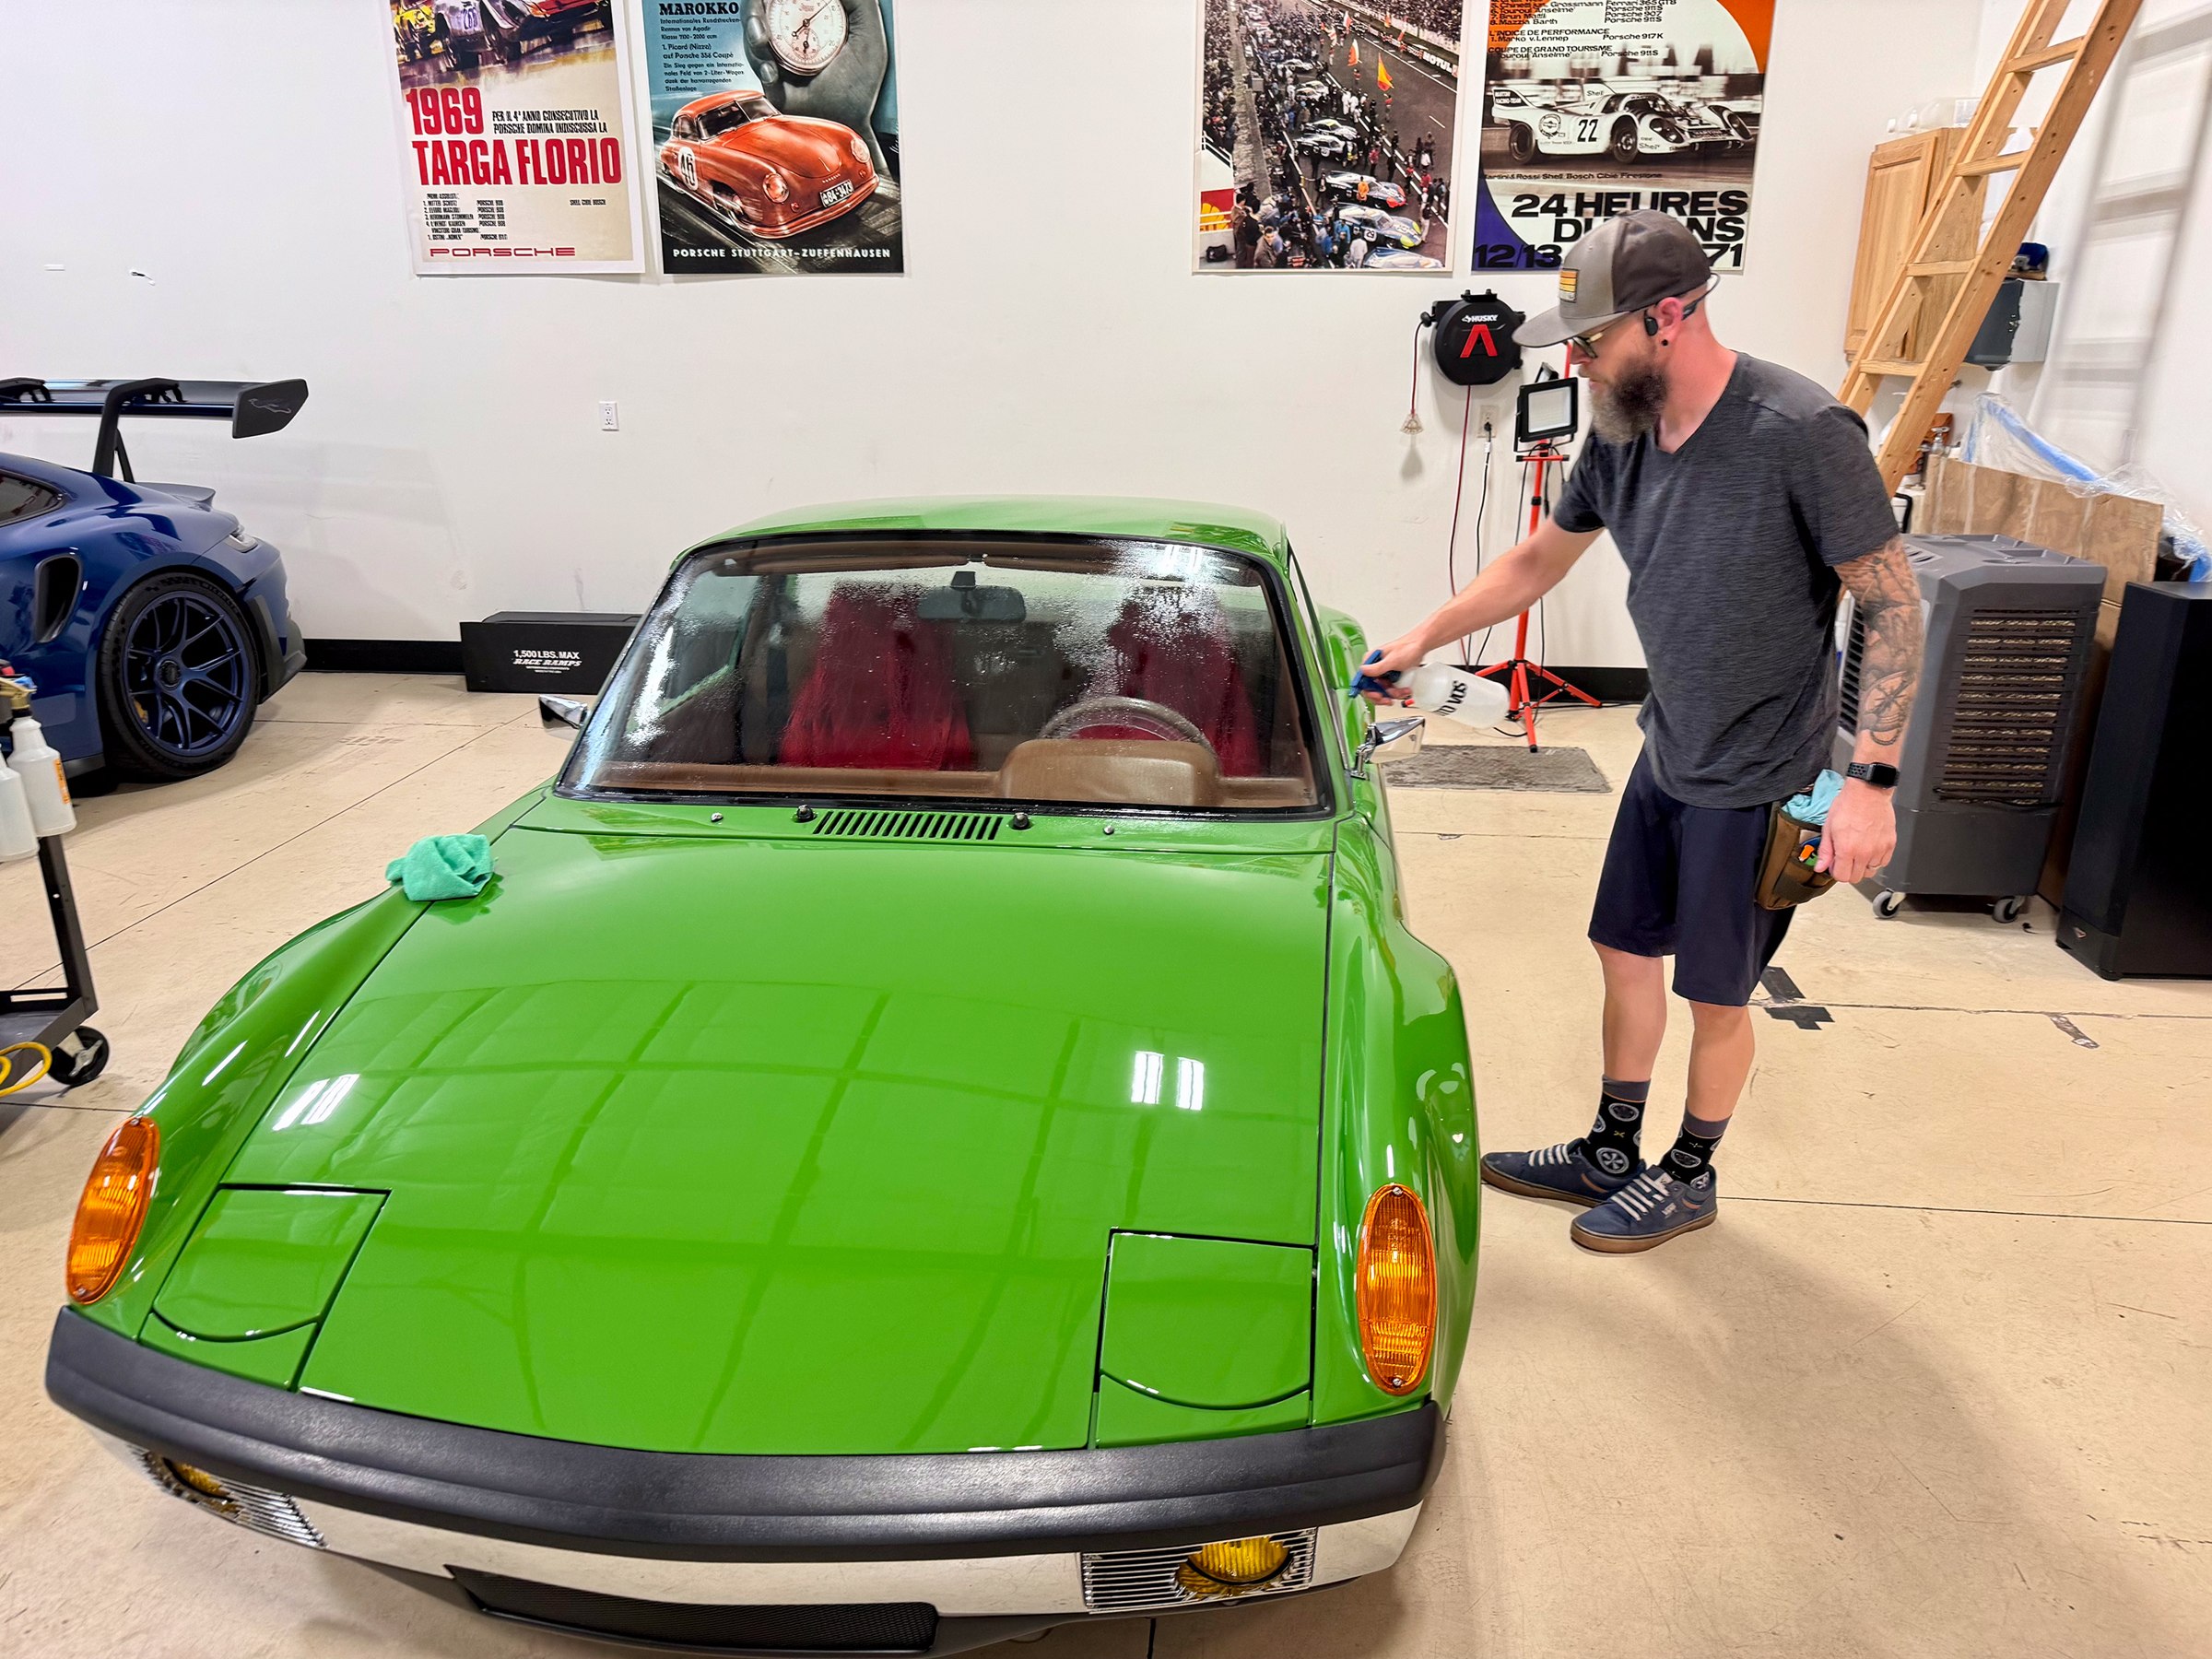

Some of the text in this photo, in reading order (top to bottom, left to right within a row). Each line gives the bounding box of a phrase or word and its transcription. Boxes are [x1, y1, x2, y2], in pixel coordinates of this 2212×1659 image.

[659, 2, 739, 15] MAROKKO
[406, 88, 484, 135] 1969
[492, 111, 505, 121] PER
[523, 110, 541, 121] ANNO
[543, 109, 589, 121] CONSECUTIVO
[590, 110, 599, 120] LA
[493, 122, 608, 134] PORSCHE DOMINA INDISCUSSA LA
[1577, 119, 1598, 142] 22
[412, 137, 622, 185] TARGA FLORIO
[681, 153, 696, 186] 46
[1512, 190, 1748, 218] 24 HEURES
[430, 248, 576, 257] PORSCHE
[673, 248, 891, 258] PORSCHE STUTTGART-ZUFFENHAUSEN
[1471, 314, 1499, 323] HUSKY
[513, 650, 537, 658] 1,500
